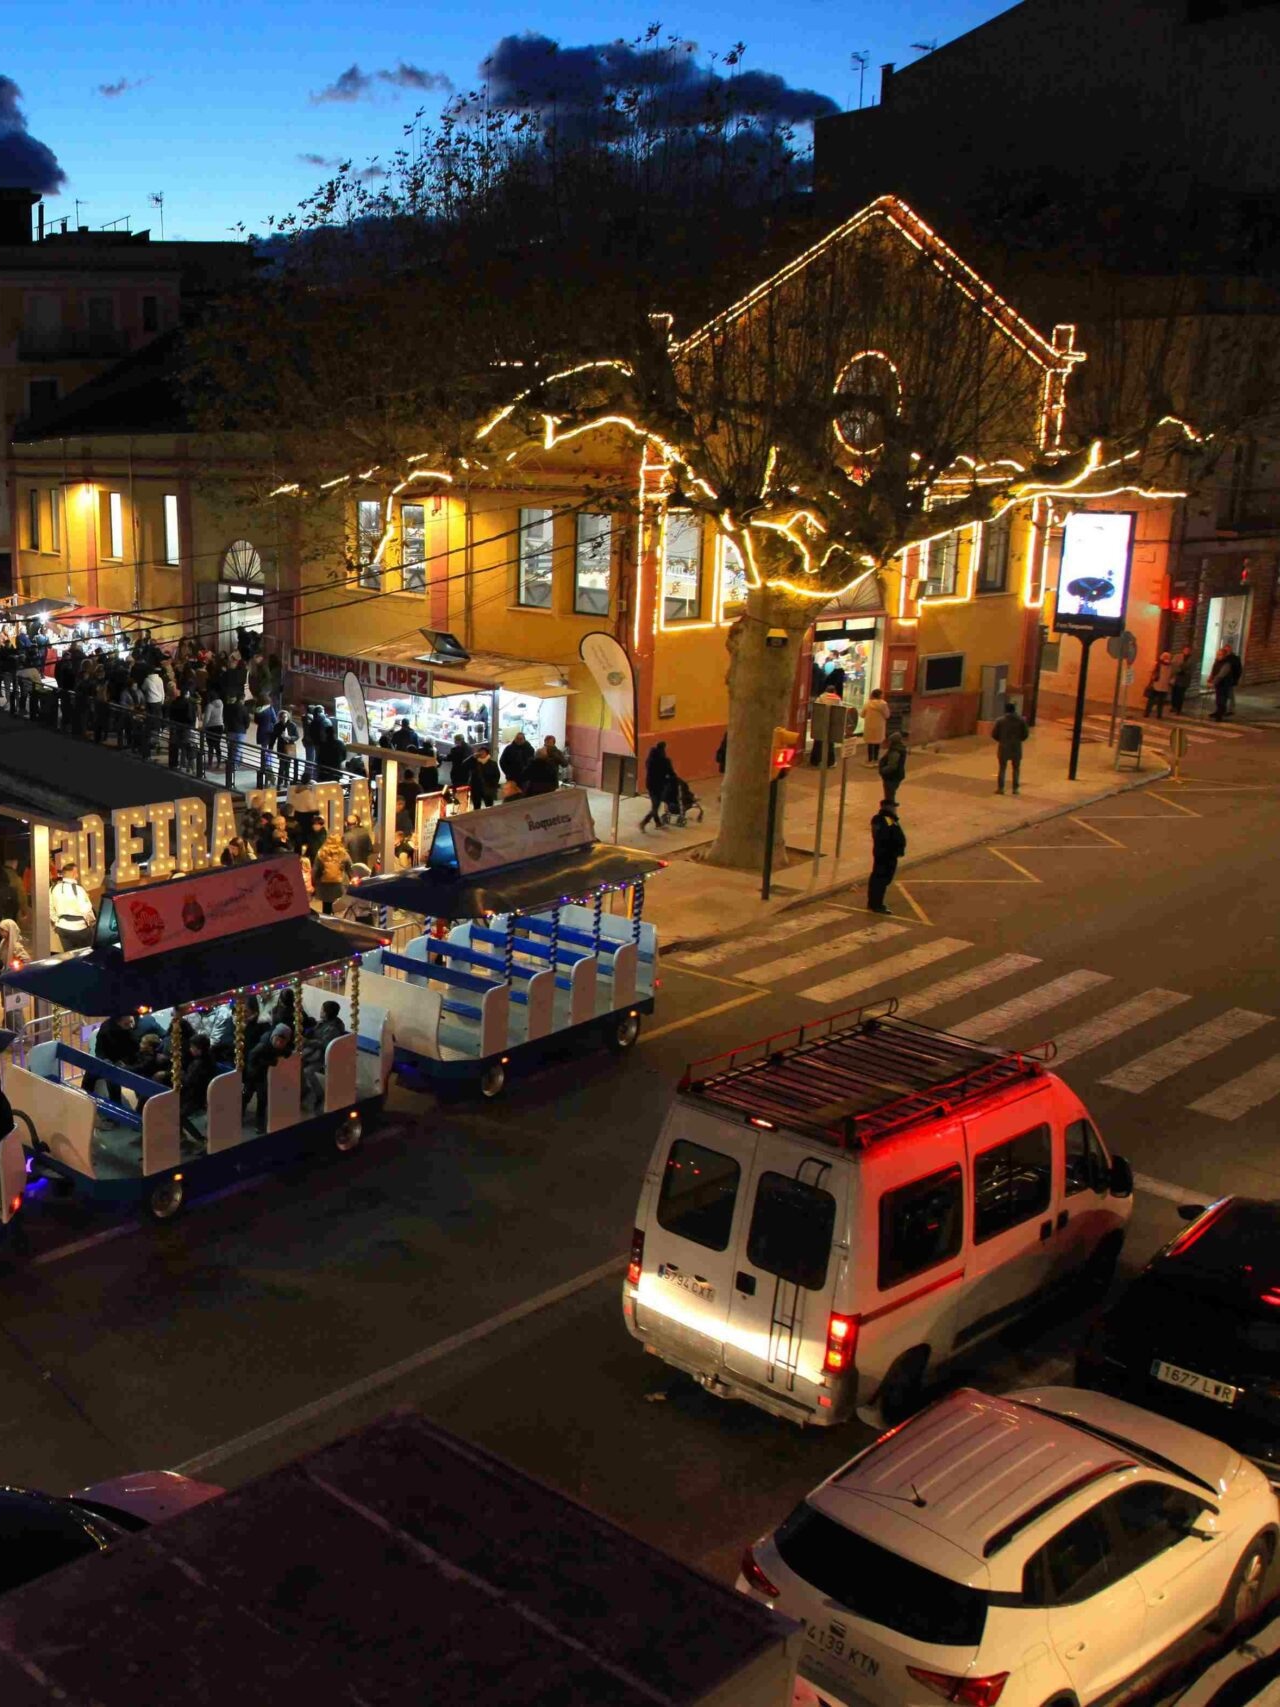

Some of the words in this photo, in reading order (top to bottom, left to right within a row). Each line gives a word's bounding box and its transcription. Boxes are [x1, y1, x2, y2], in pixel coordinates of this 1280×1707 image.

[375, 663, 428, 695] LOPEZ
[527, 813, 572, 832] Roquetes
[1164, 1365, 1199, 1387] 1677
[807, 1625, 845, 1655] 4139
[849, 1647, 880, 1676] KTN
